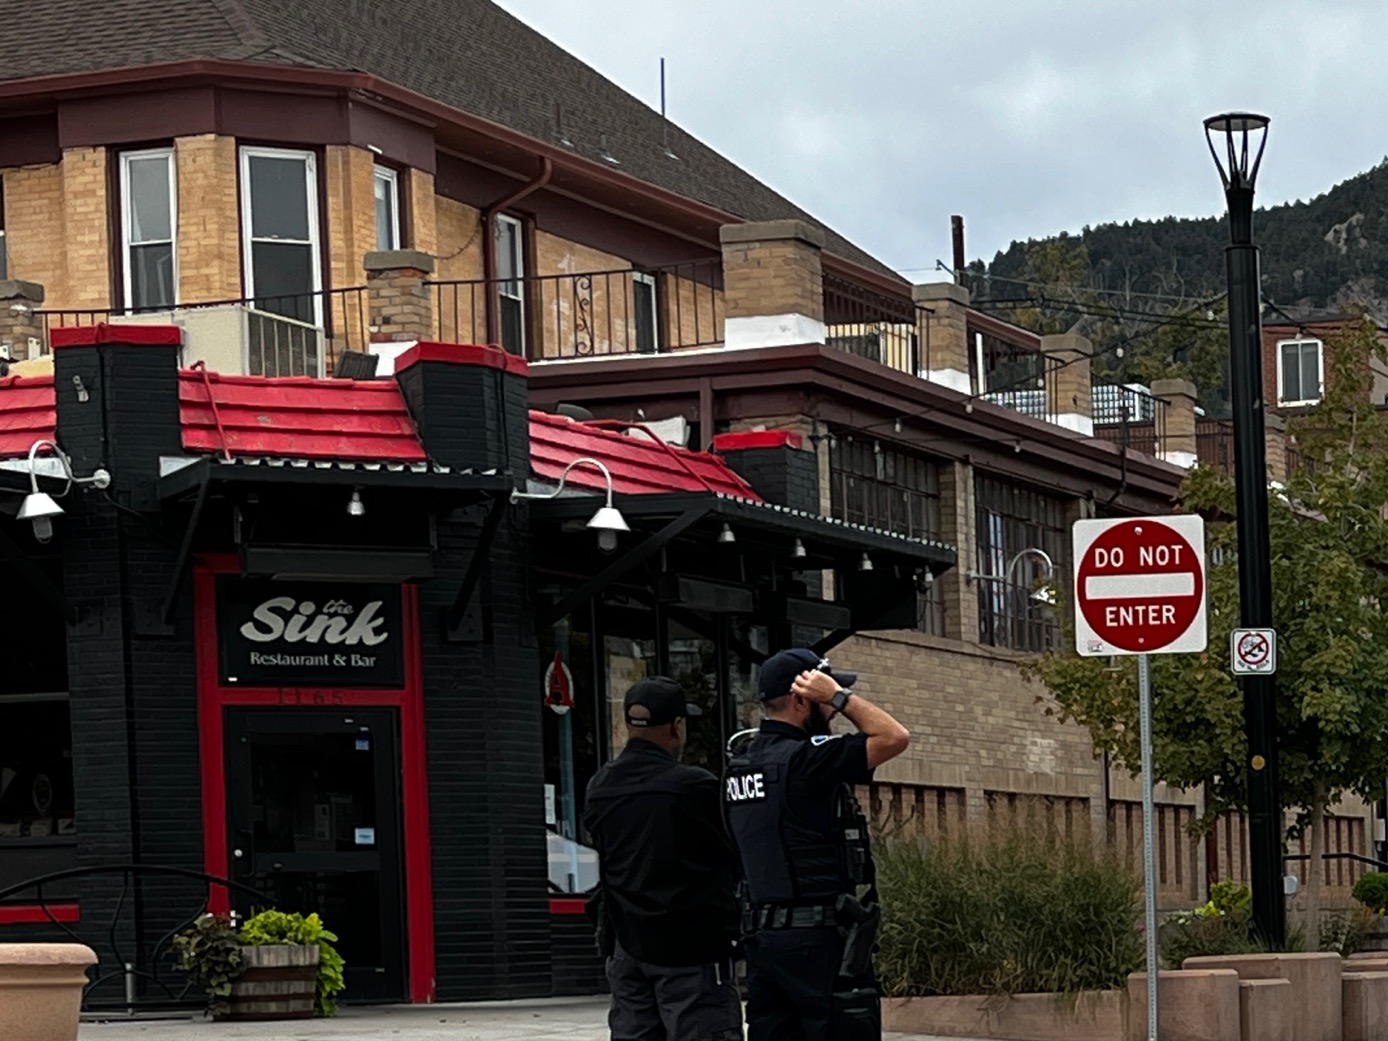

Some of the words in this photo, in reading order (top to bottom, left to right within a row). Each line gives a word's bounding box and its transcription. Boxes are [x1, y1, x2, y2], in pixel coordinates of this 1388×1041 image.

[1094, 547, 1124, 568] DO
[1139, 545, 1183, 567] NOT
[322, 600, 354, 614] the
[1105, 605, 1176, 626] ENTER
[240, 597, 389, 646] Sink
[250, 652, 329, 666] Restaurant
[333, 654, 346, 666] &
[351, 654, 376, 667] Bar
